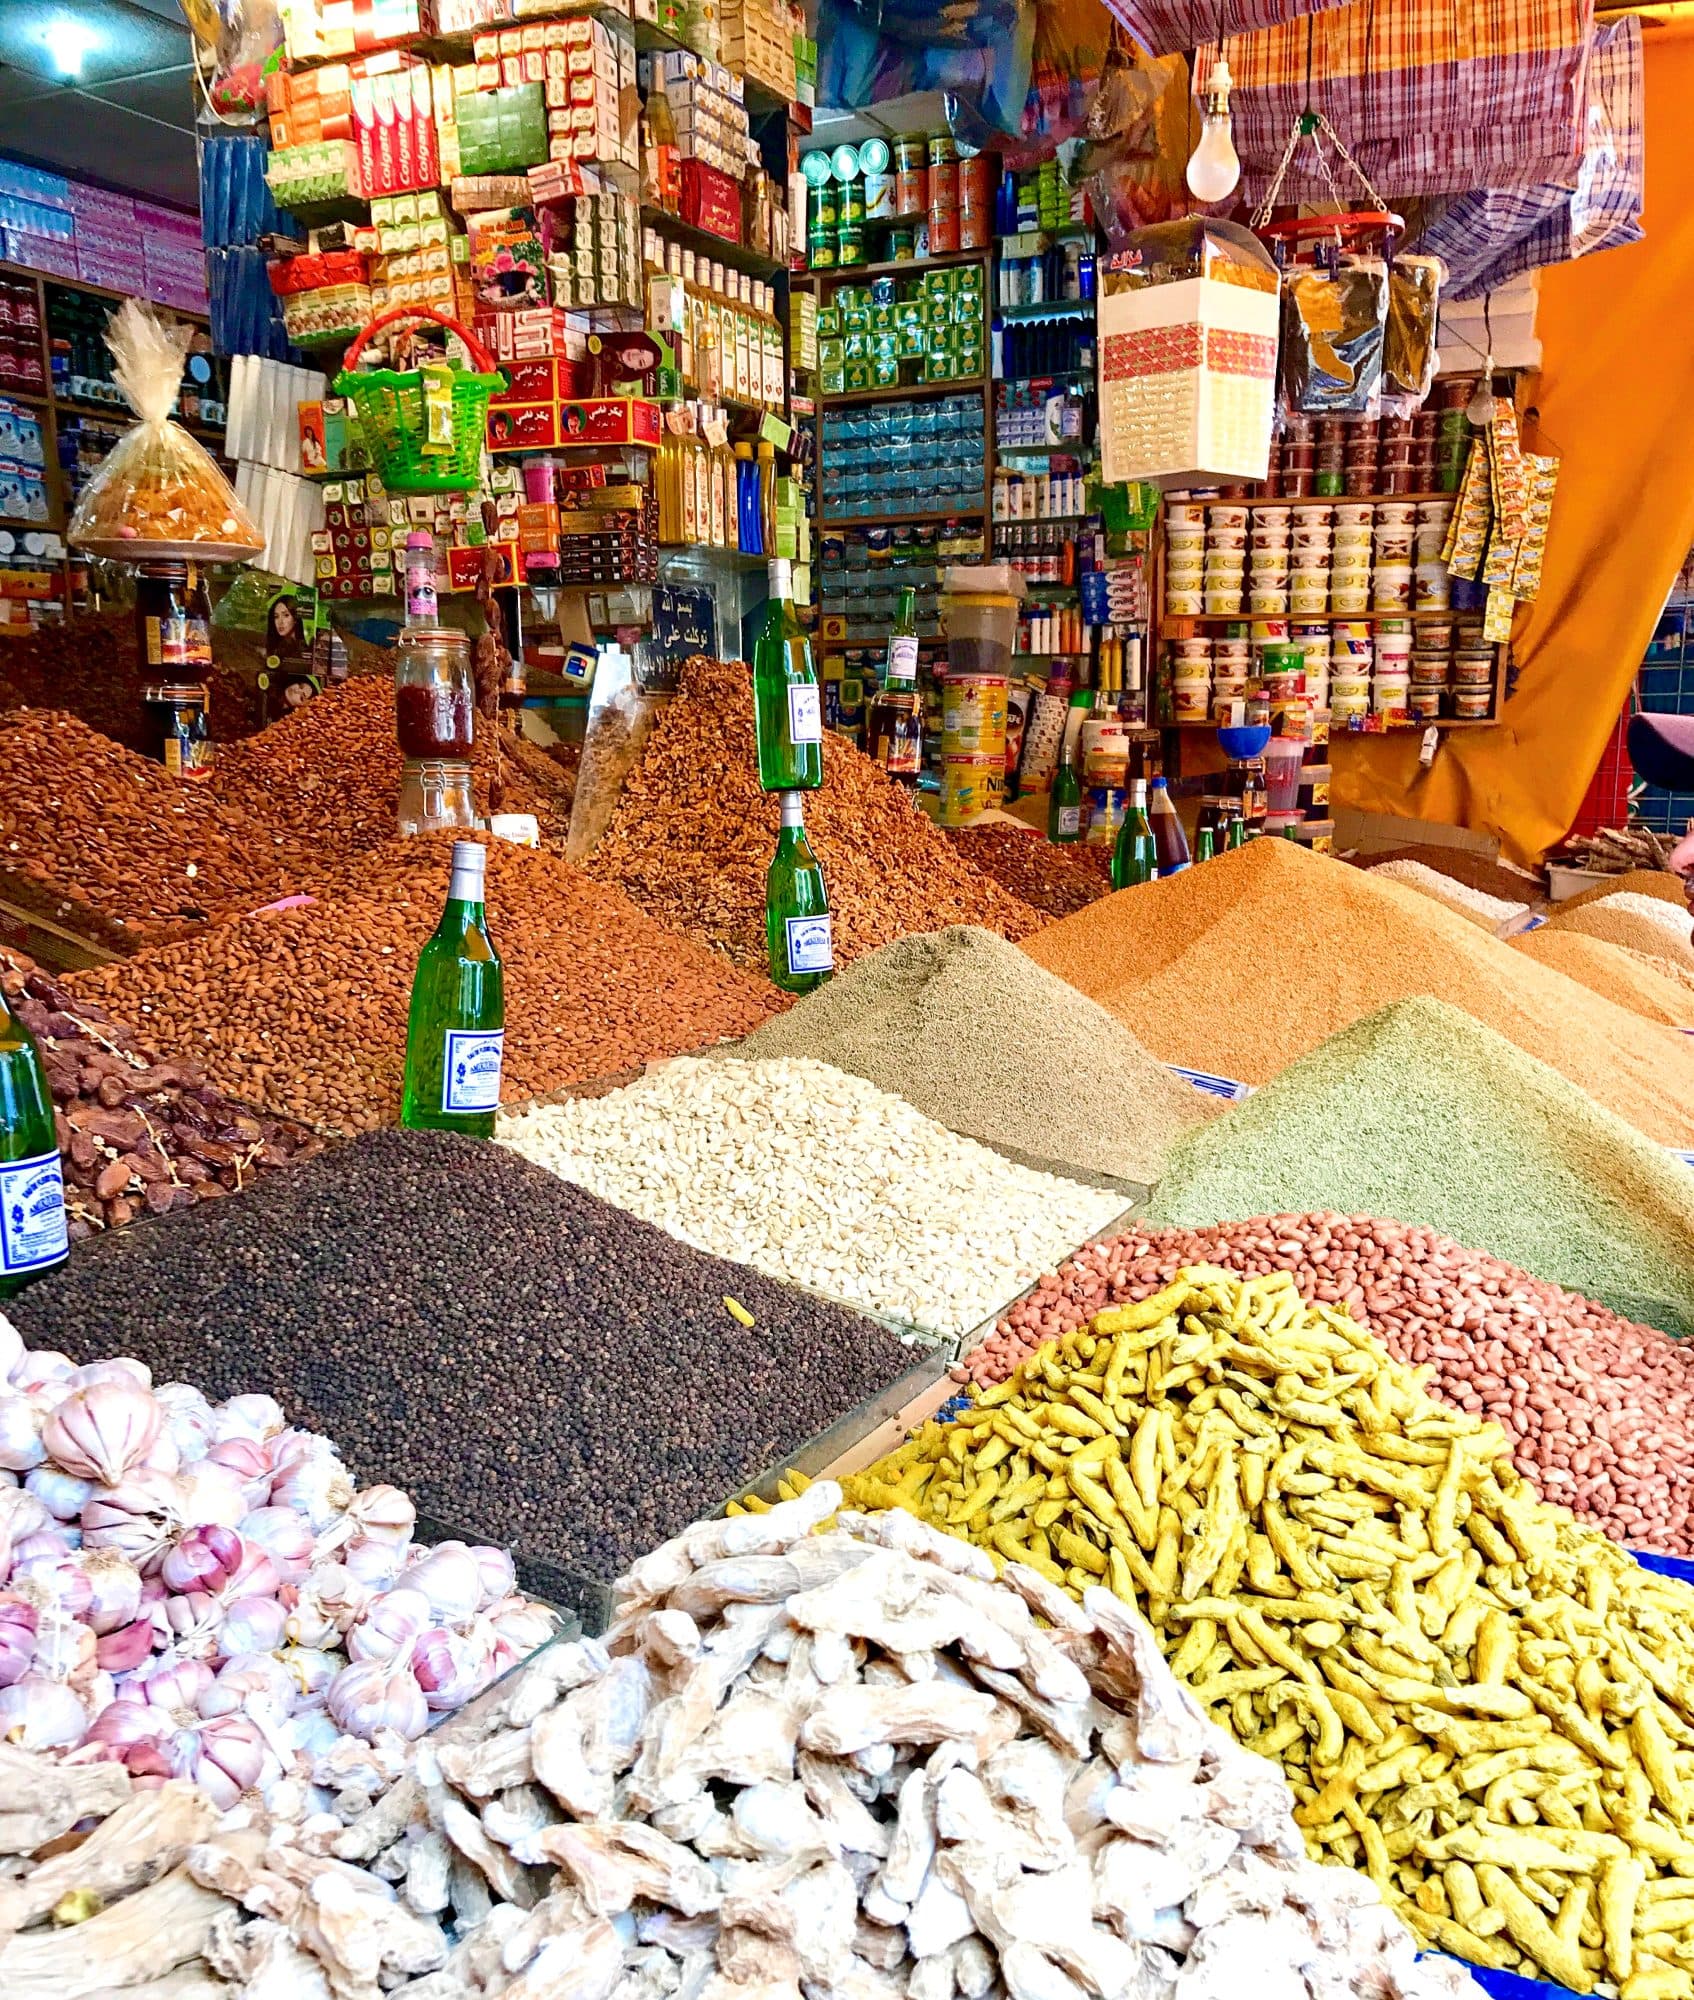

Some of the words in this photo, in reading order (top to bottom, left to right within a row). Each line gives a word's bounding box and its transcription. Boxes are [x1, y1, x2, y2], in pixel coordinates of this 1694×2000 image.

[361, 128, 374, 191] Colgate
[380, 125, 392, 189] Colgate
[399, 121, 411, 187] Colgate
[417, 118, 429, 182] Colgate
[664, 624, 680, 648] على
[677, 603, 692, 620] بسم
[684, 626, 708, 649] توكلت
